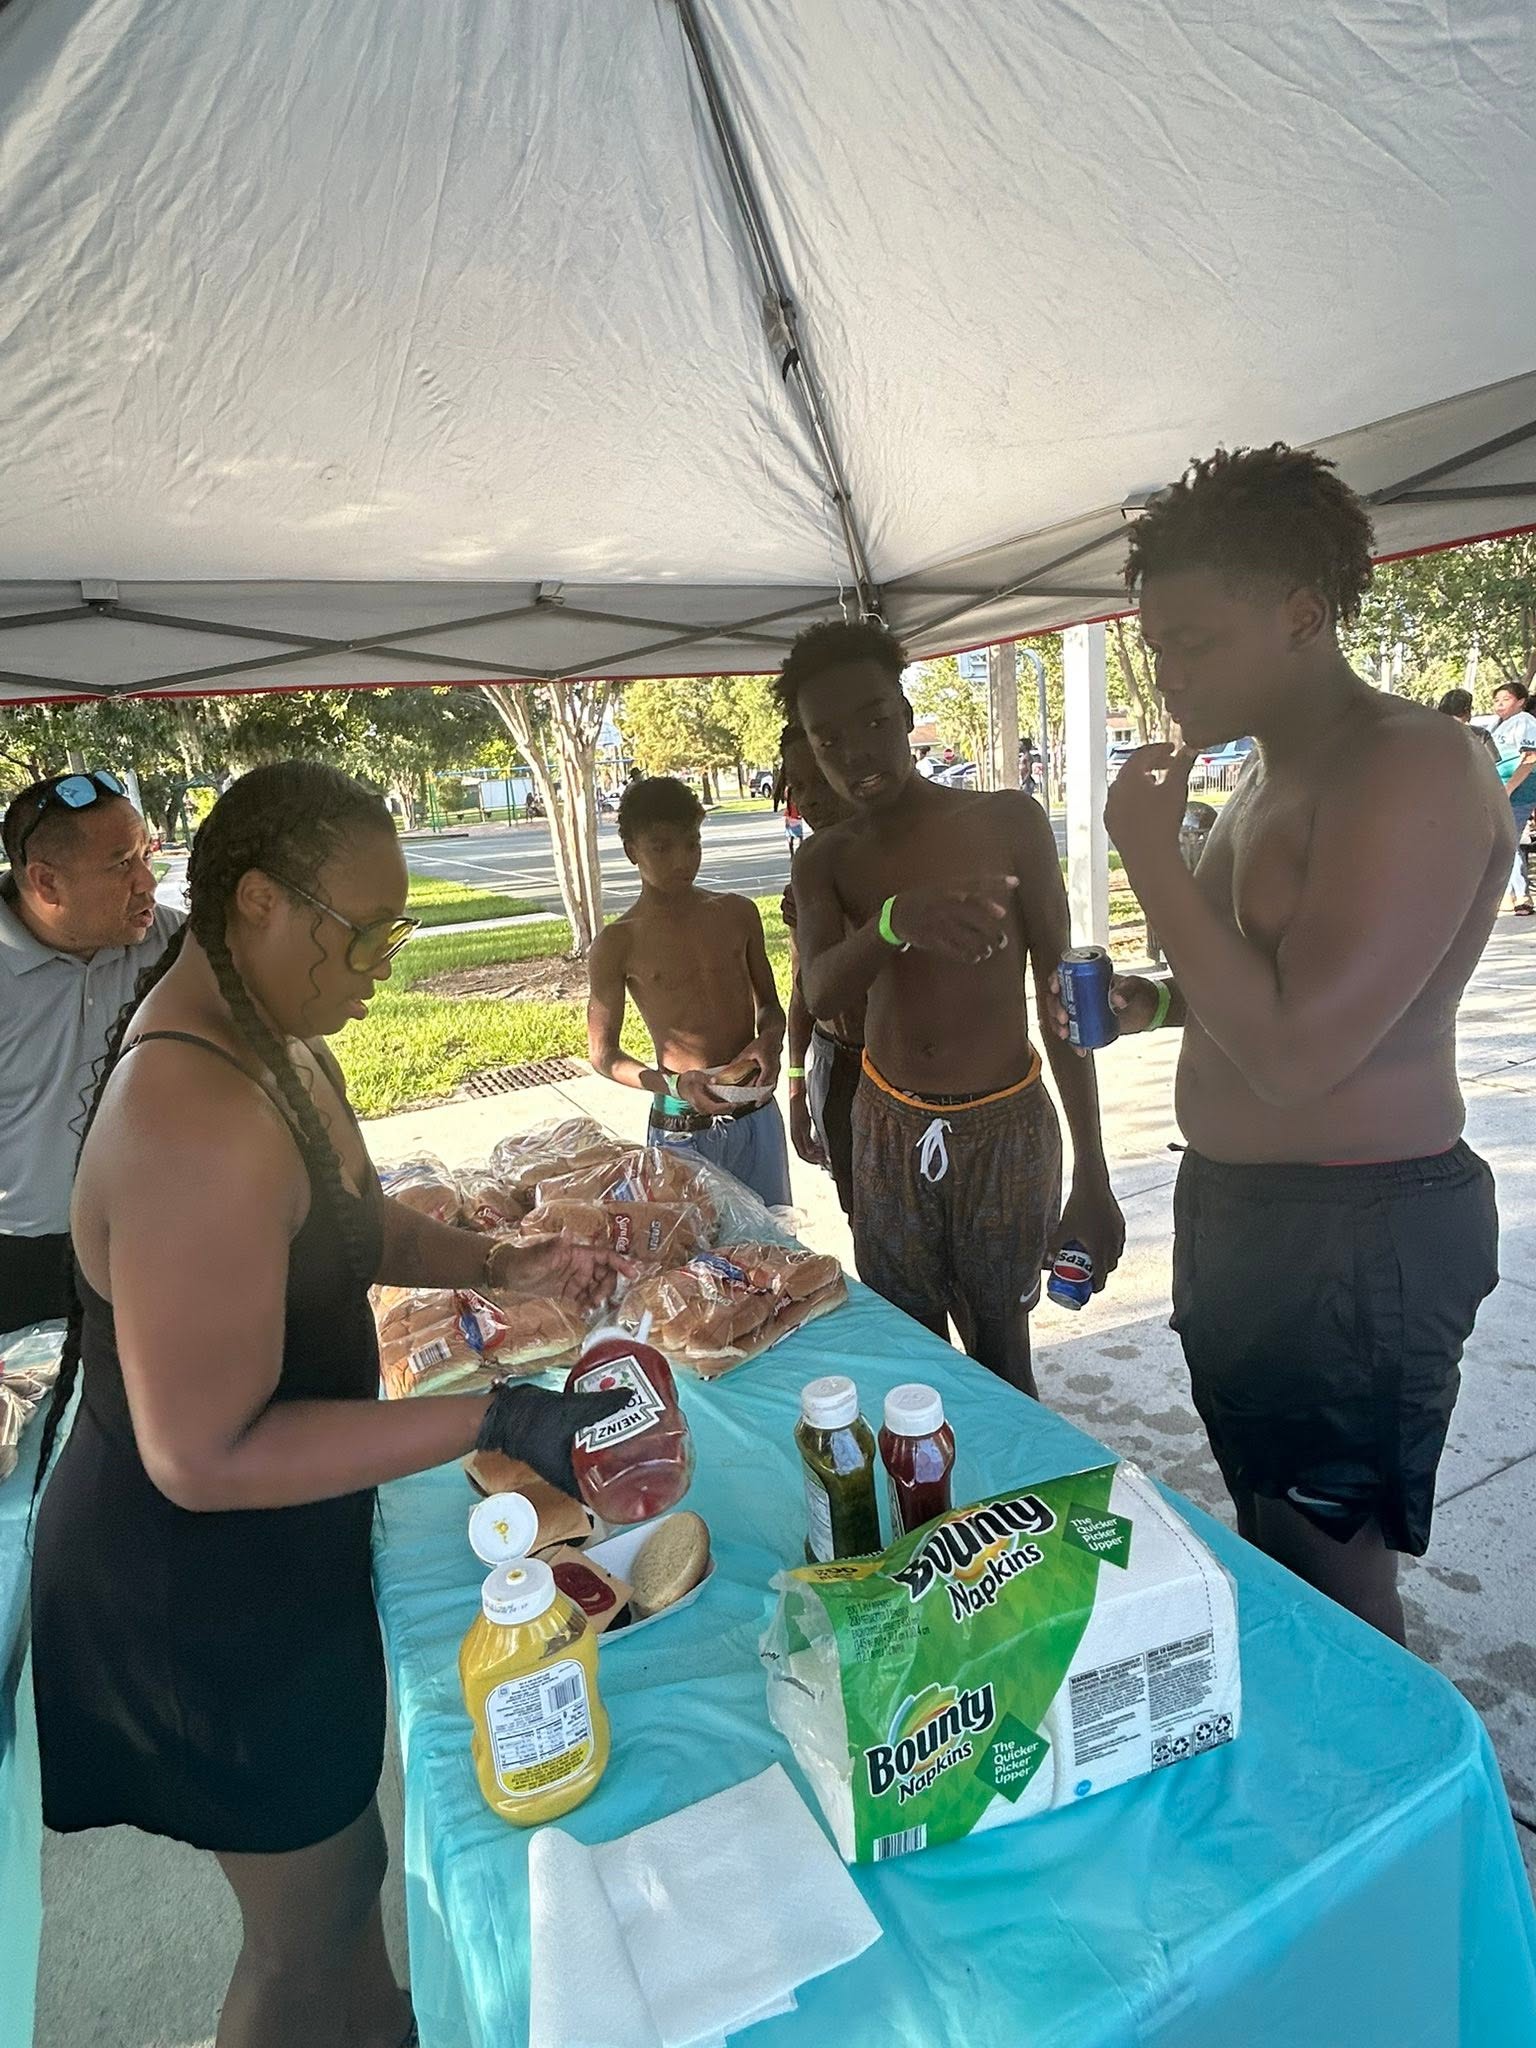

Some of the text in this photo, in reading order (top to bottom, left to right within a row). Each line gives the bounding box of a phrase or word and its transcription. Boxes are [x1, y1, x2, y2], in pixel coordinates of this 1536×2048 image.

[598, 1412, 643, 1439] HEINZ
[1070, 1517, 1092, 1527] The
[1076, 1518, 1118, 1534] Quicker
[1082, 1528, 1117, 1543] Picker
[1088, 1536, 1123, 1551] Upper
[892, 1495, 1056, 1600] Bounty
[947, 1545, 1042, 1621] Napkins
[866, 1684, 995, 1797] Bounty
[992, 1741, 1016, 1754] The
[993, 1742, 1039, 1766] Quicker
[899, 1742, 973, 1804] Napkins
[995, 1756, 1032, 1776] Picker
[995, 1767, 1032, 1784] Upper
